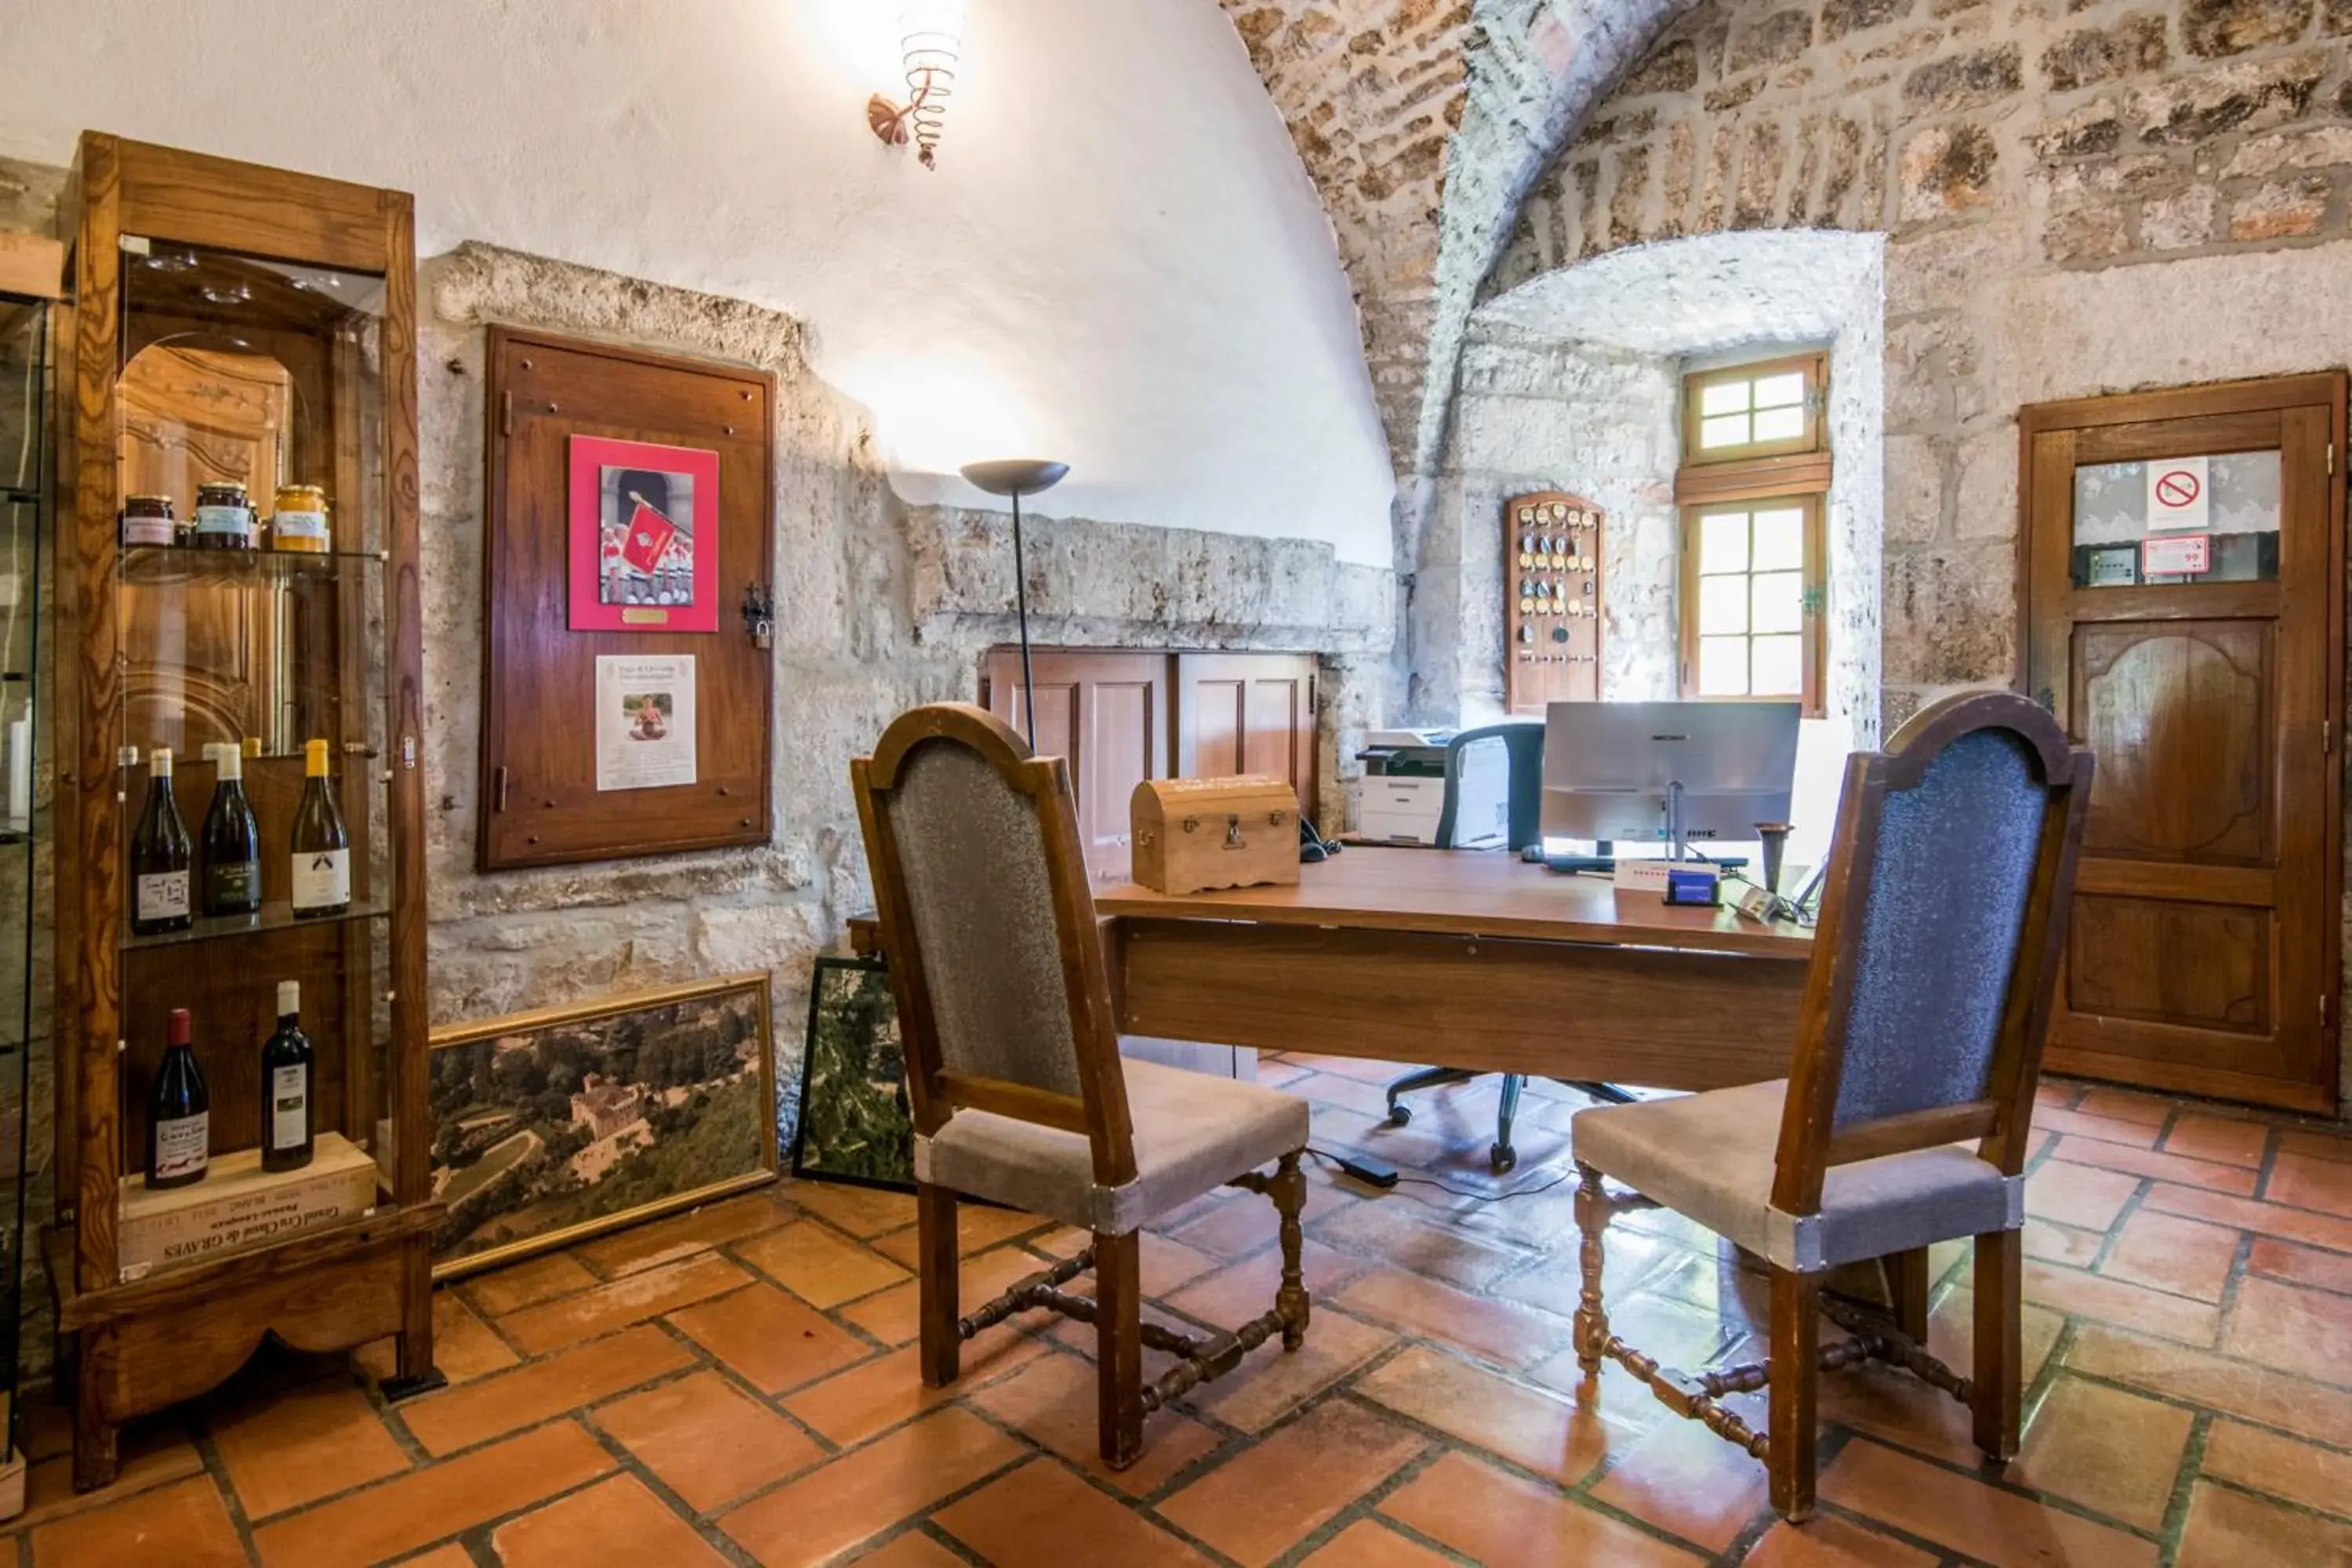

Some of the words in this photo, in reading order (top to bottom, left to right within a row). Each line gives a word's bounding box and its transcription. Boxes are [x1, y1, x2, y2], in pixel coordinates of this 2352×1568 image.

[279, 1215, 303, 1229] Cru
[230, 1229, 244, 1243] de
[164, 1236, 225, 1259] GRAVES
